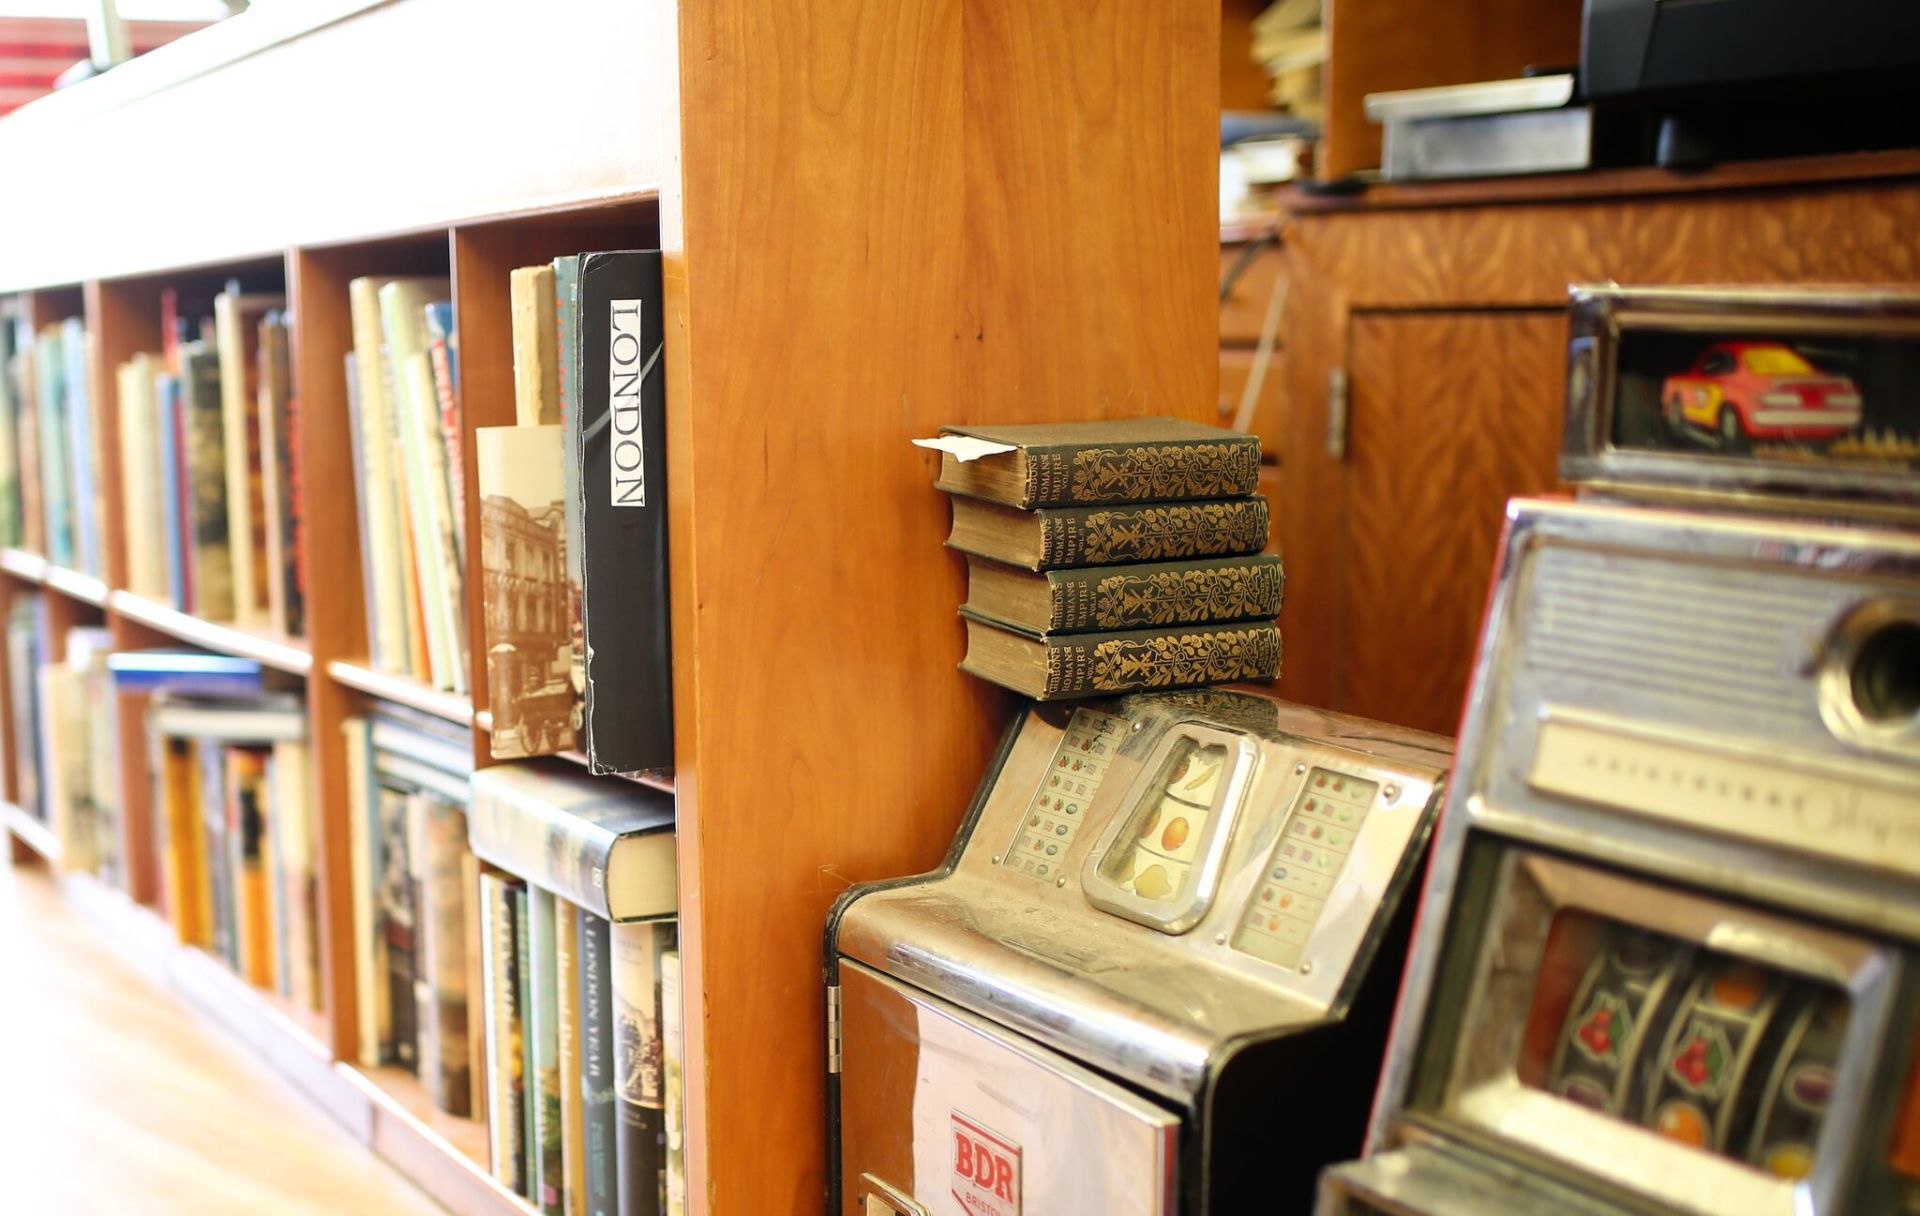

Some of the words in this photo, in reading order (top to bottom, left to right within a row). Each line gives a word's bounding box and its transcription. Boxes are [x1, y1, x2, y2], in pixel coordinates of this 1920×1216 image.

[612, 305, 643, 505] LONDON
[1051, 453, 1062, 501] EMPIRE
[1065, 518, 1077, 564] EMPIRE
[1077, 581, 1088, 627] EMPIRE
[1074, 646, 1086, 691] EMPIRE
[955, 1131, 1013, 1204] BDR
